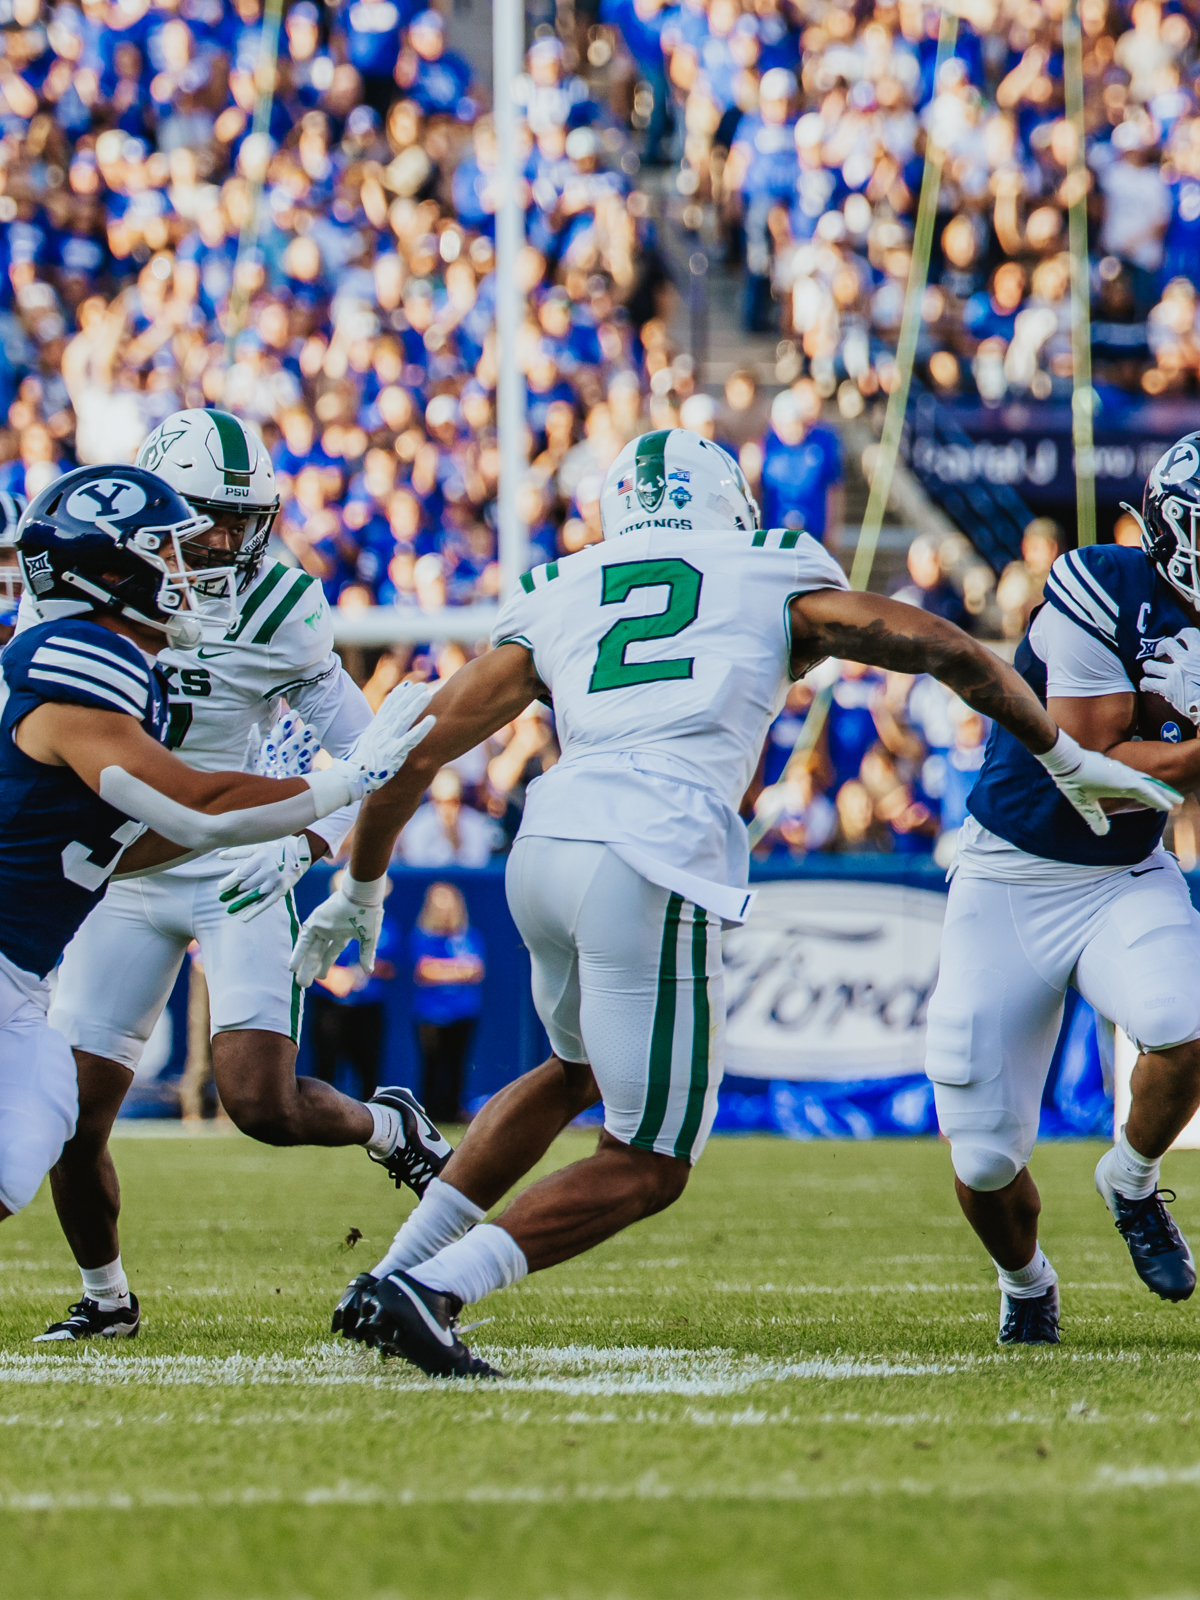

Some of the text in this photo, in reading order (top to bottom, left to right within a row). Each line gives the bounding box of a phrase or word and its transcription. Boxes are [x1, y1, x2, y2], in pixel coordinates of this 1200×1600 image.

[1159, 445, 1194, 478] Y
[76, 482, 132, 517] Y
[225, 487, 250, 497] PSU
[587, 557, 704, 694] 2
[1136, 602, 1151, 634] C
